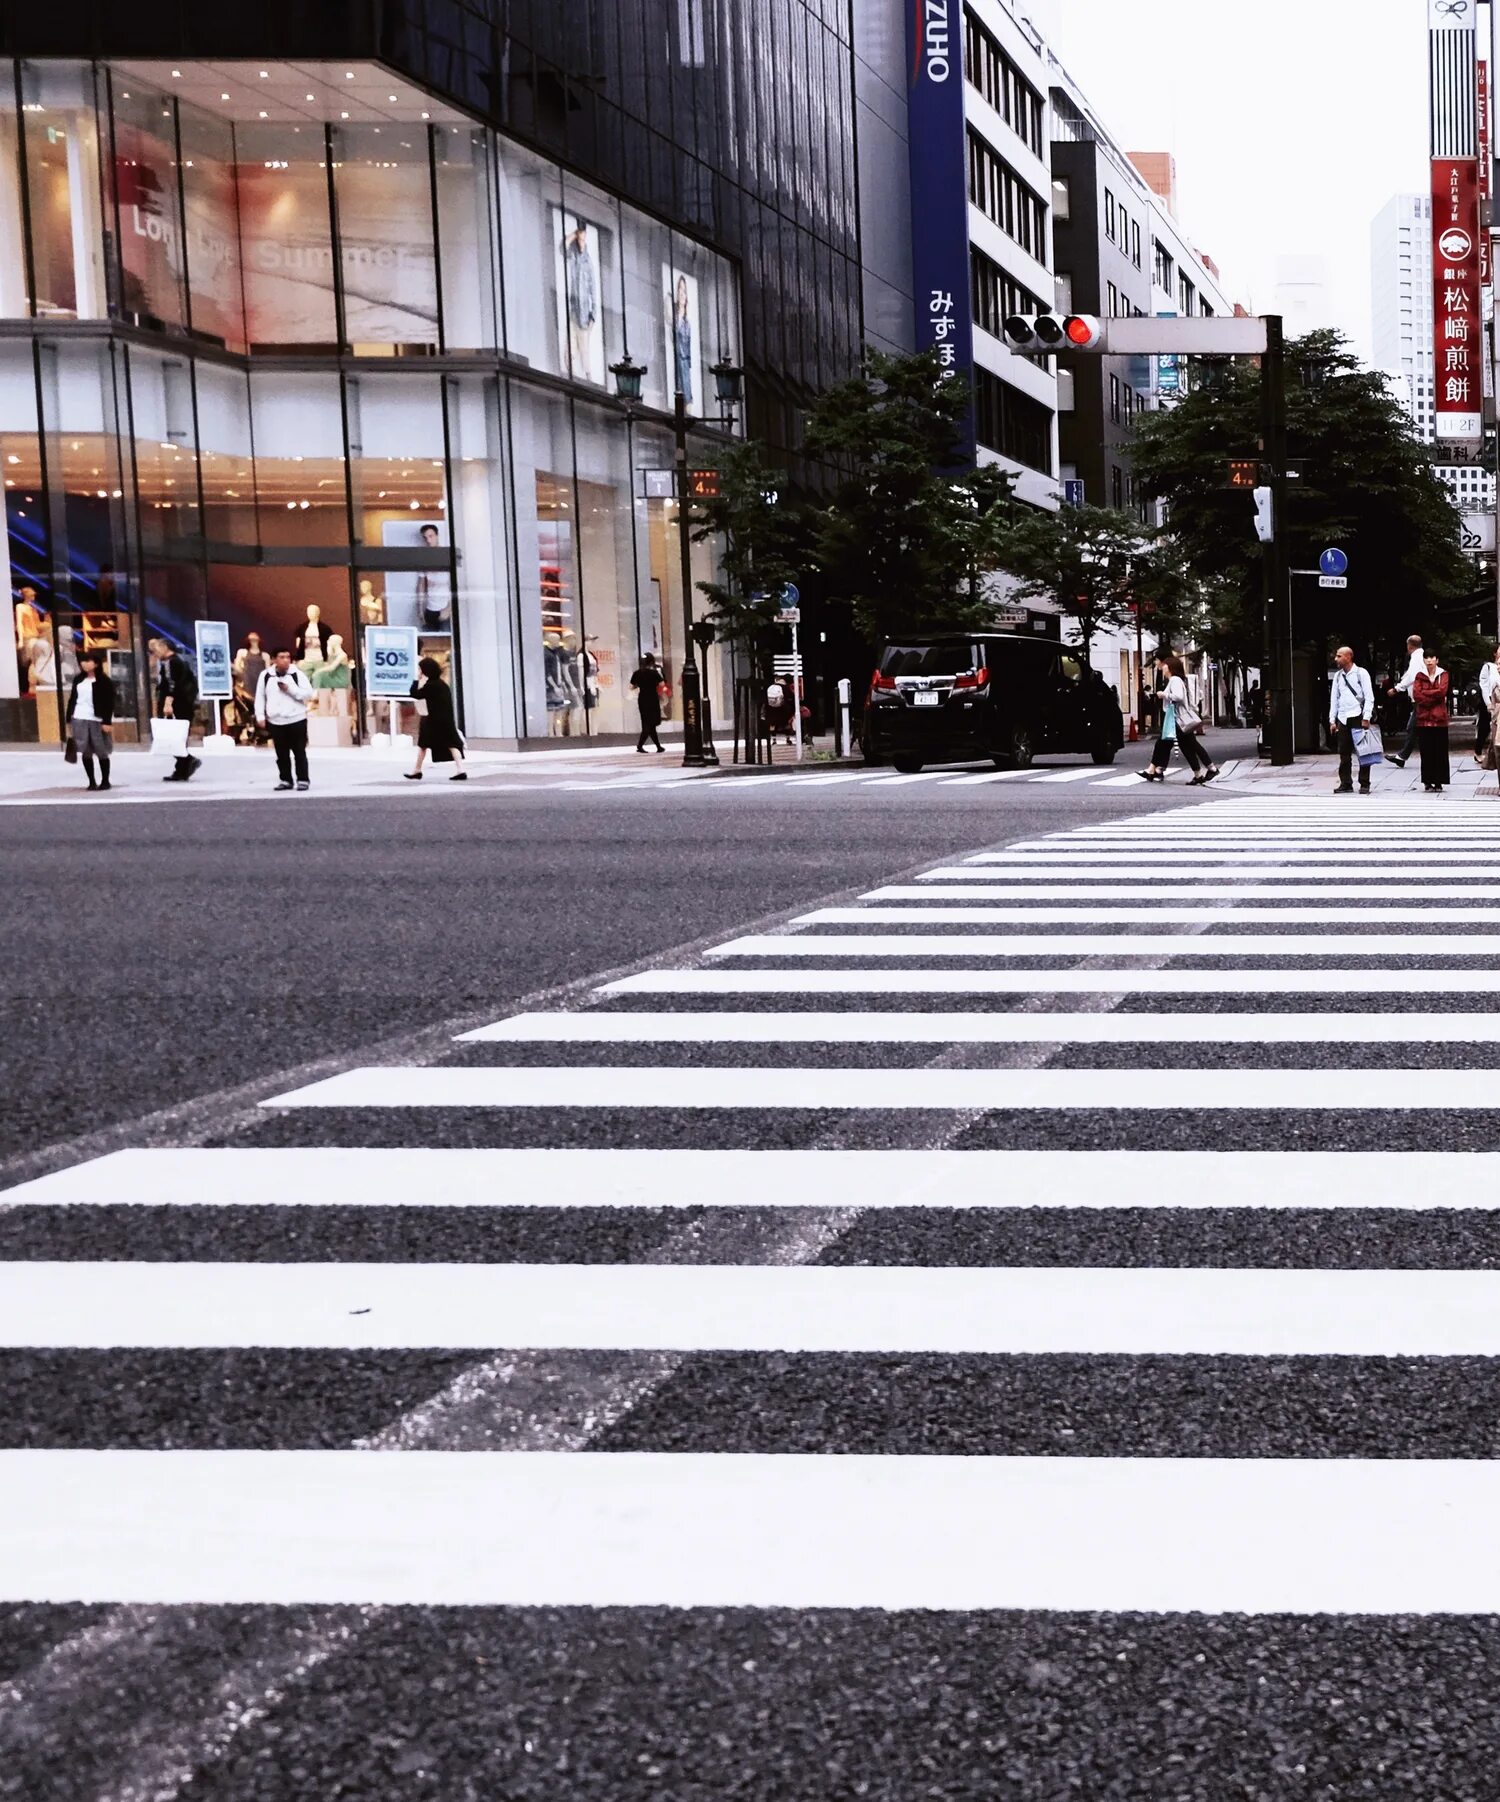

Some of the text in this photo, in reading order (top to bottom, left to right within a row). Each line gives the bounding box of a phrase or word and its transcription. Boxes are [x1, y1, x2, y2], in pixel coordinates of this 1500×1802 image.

[257, 240, 405, 269] Summer
[1443, 268, 1467, 280] 銀座
[930, 290, 956, 389] みずほ
[1462, 535, 1482, 549] 22
[375, 651, 409, 666] 50%
